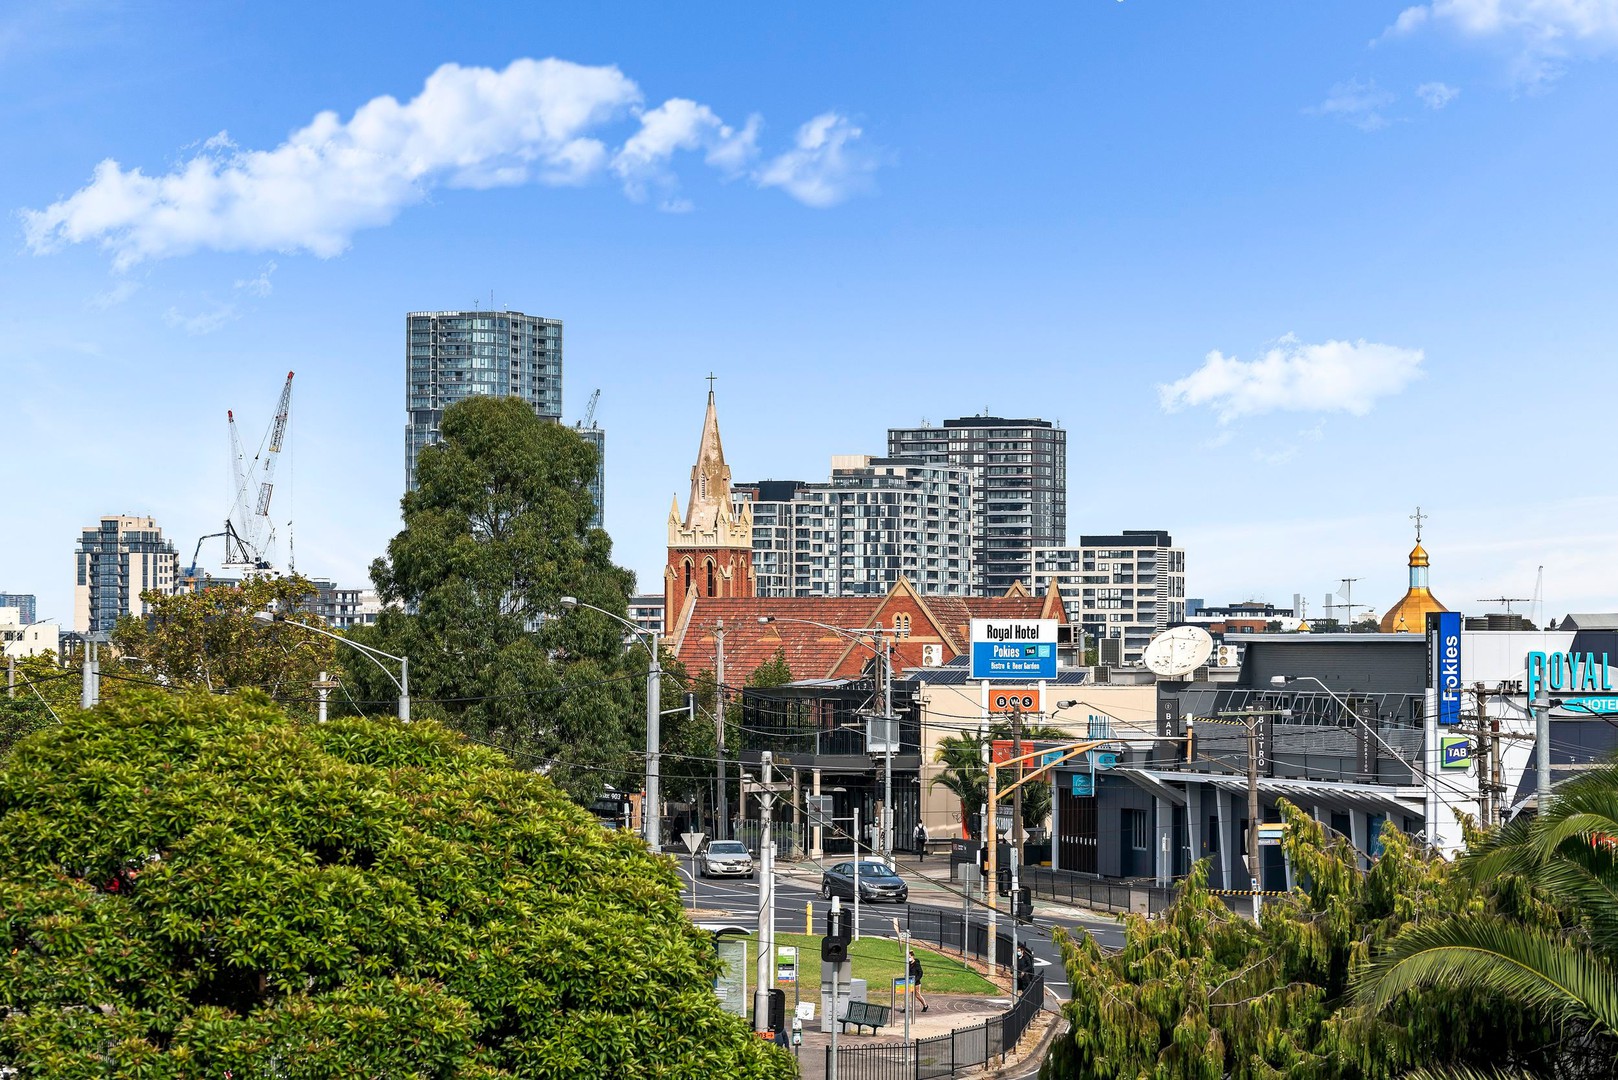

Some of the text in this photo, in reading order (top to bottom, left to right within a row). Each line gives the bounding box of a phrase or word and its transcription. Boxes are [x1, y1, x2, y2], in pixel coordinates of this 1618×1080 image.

[987, 624, 1039, 642] Royal Hotel
[993, 645, 1020, 658] Pokies
[1442, 635, 1458, 701] Pokies
[1501, 680, 1522, 692] THE
[1527, 651, 1612, 718] ROYAL
[1447, 747, 1467, 758] TAB
